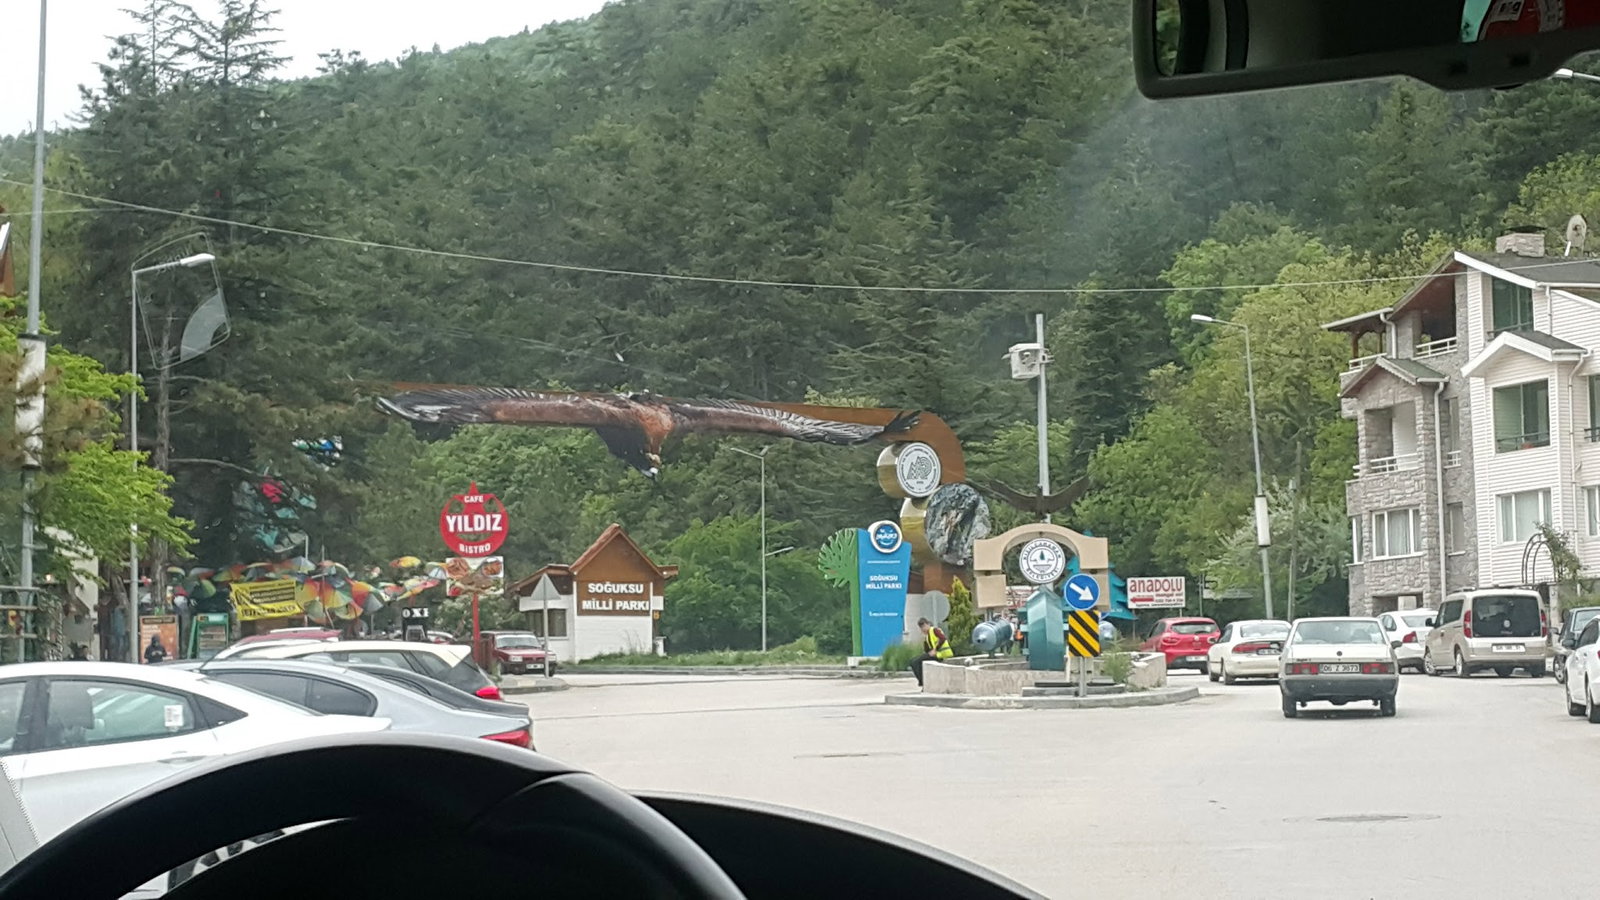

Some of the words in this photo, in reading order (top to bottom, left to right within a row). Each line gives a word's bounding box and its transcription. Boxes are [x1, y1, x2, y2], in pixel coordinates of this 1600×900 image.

[464, 495, 483, 503] CAFE
[446, 514, 502, 532] YILDIZ
[588, 581, 644, 594] SOĞUKSU
[582, 598, 613, 610] MİLLİ
[615, 600, 650, 611] PARKI
